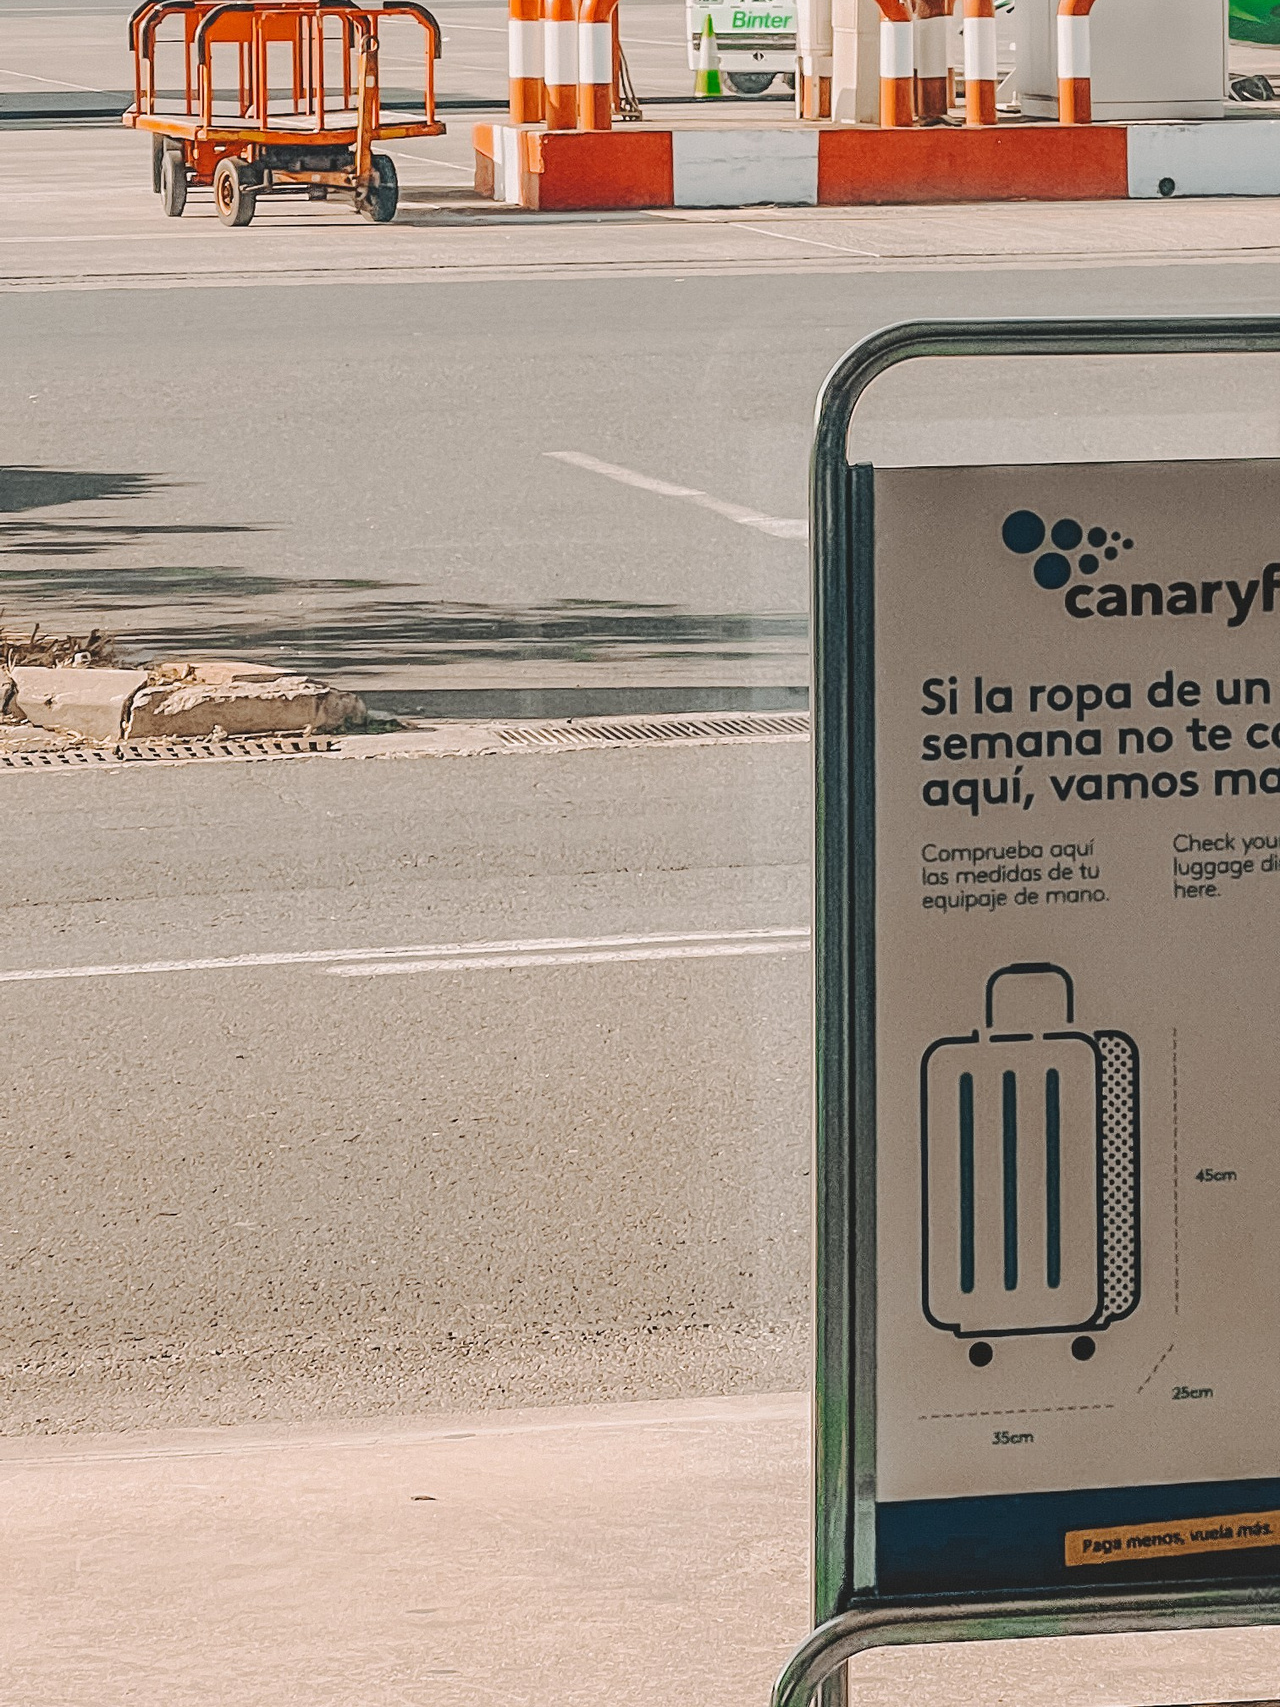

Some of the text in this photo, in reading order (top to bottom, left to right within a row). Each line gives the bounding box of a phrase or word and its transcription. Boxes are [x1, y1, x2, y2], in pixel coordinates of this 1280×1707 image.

[732, 11, 792, 29] Binter
[922, 676, 957, 715] Si
[975, 675, 1013, 714] la
[1029, 682, 1131, 721] ropa
[1147, 671, 1200, 709] de
[1216, 676, 1271, 706] un
[922, 726, 1101, 760] semana
[1119, 727, 1172, 755] no
[1186, 718, 1232, 751] te
[922, 765, 1034, 816] aquí,
[1049, 767, 1199, 802] vamos
[922, 838, 1095, 869] Comprueba aquí
[1173, 833, 1235, 853] Check
[922, 861, 1100, 886] las medidas de tu
[1173, 855, 1254, 879] luggage
[922, 886, 1109, 914] equipaje de mano.
[1173, 879, 1221, 898] here.
[1195, 1168, 1237, 1182] 45cm
[1172, 1386, 1214, 1400] 25cm
[992, 1431, 1034, 1445] 35cm
[1083, 1521, 1273, 1554] Paga menos, vuela más.
